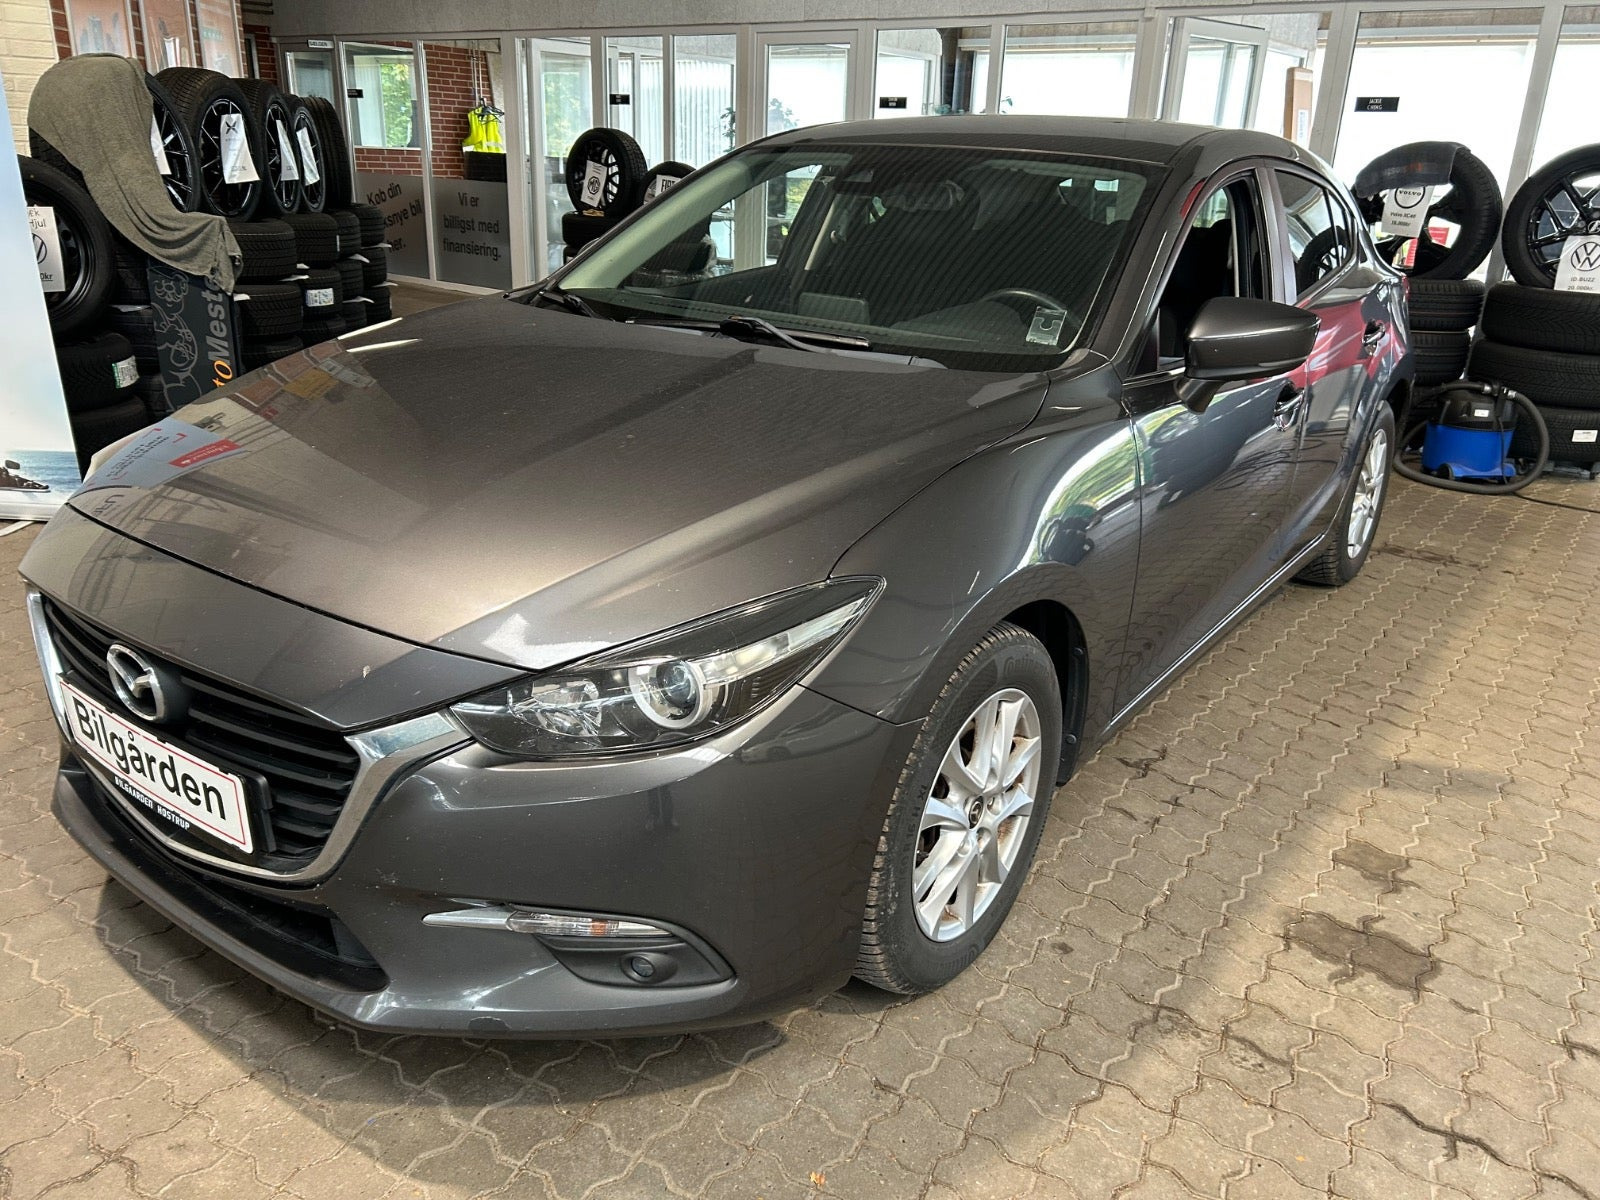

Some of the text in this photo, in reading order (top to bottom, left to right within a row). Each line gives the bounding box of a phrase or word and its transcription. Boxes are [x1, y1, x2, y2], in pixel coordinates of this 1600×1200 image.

[387, 182, 402, 200] din
[661, 179, 676, 192] FIA
[409, 198, 423, 217] bil
[458, 191, 480, 208] Vi er
[443, 214, 500, 234] billigst med
[443, 238, 502, 261] finansiering.
[72, 695, 227, 821] Bilgården
